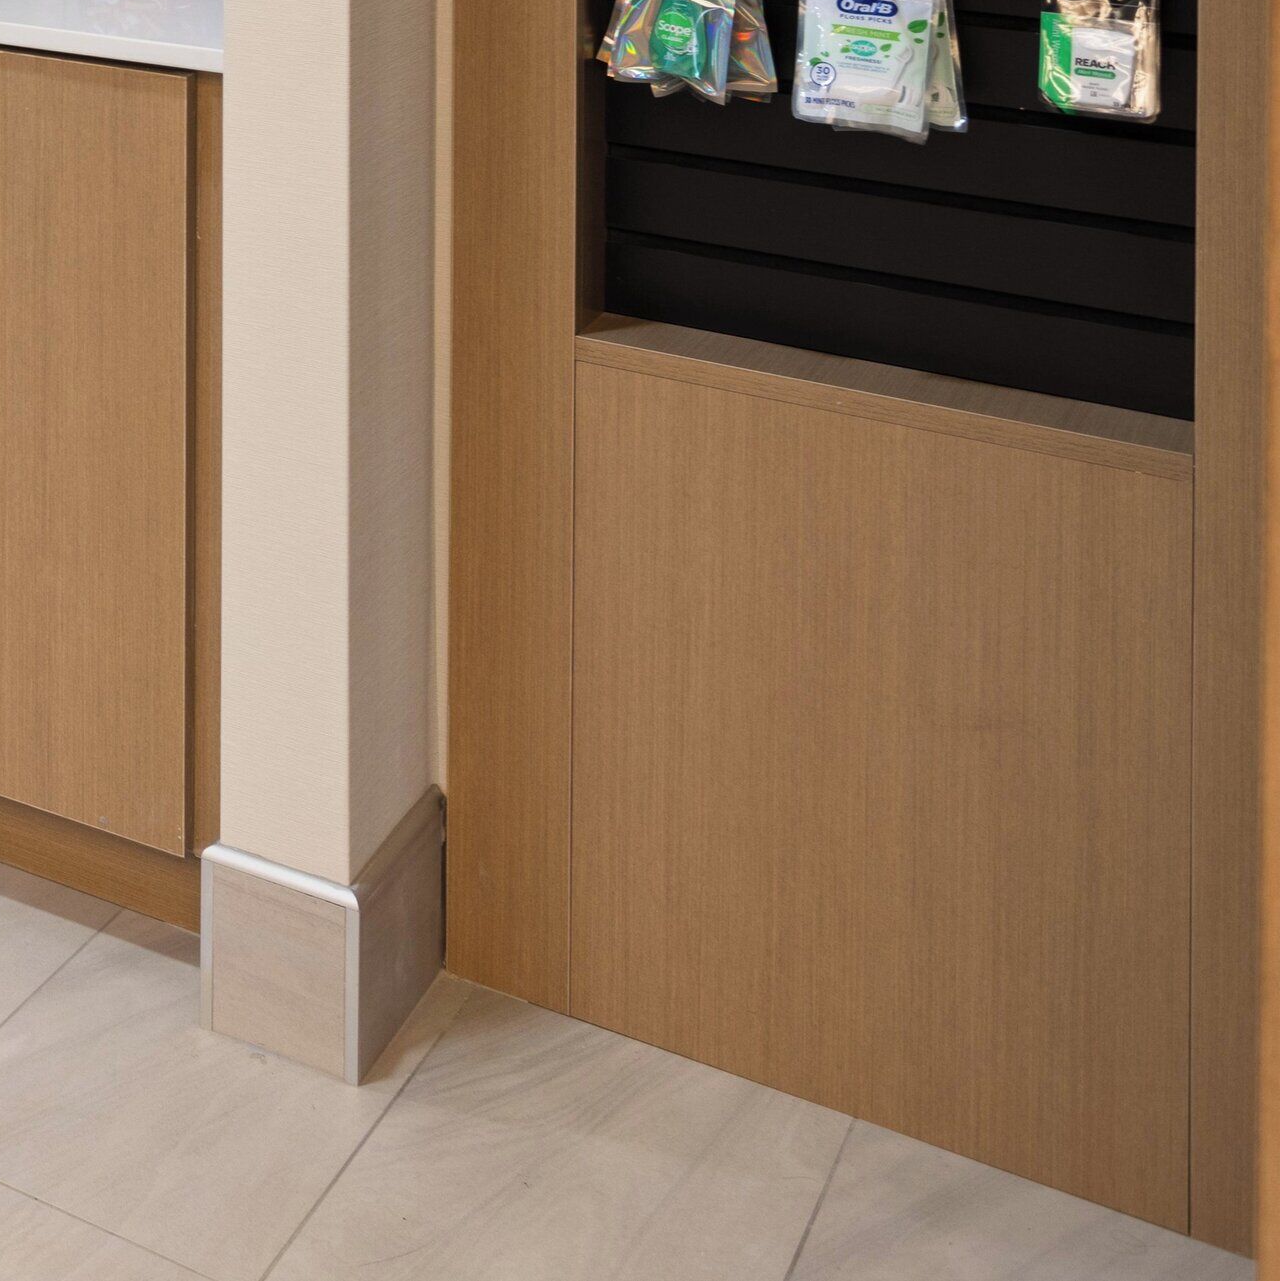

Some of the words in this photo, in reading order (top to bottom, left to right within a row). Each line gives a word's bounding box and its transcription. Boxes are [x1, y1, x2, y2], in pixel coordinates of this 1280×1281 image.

[867, 16, 892, 24] PICKS
[657, 20, 691, 35] Scope
[816, 67, 830, 75] 30
